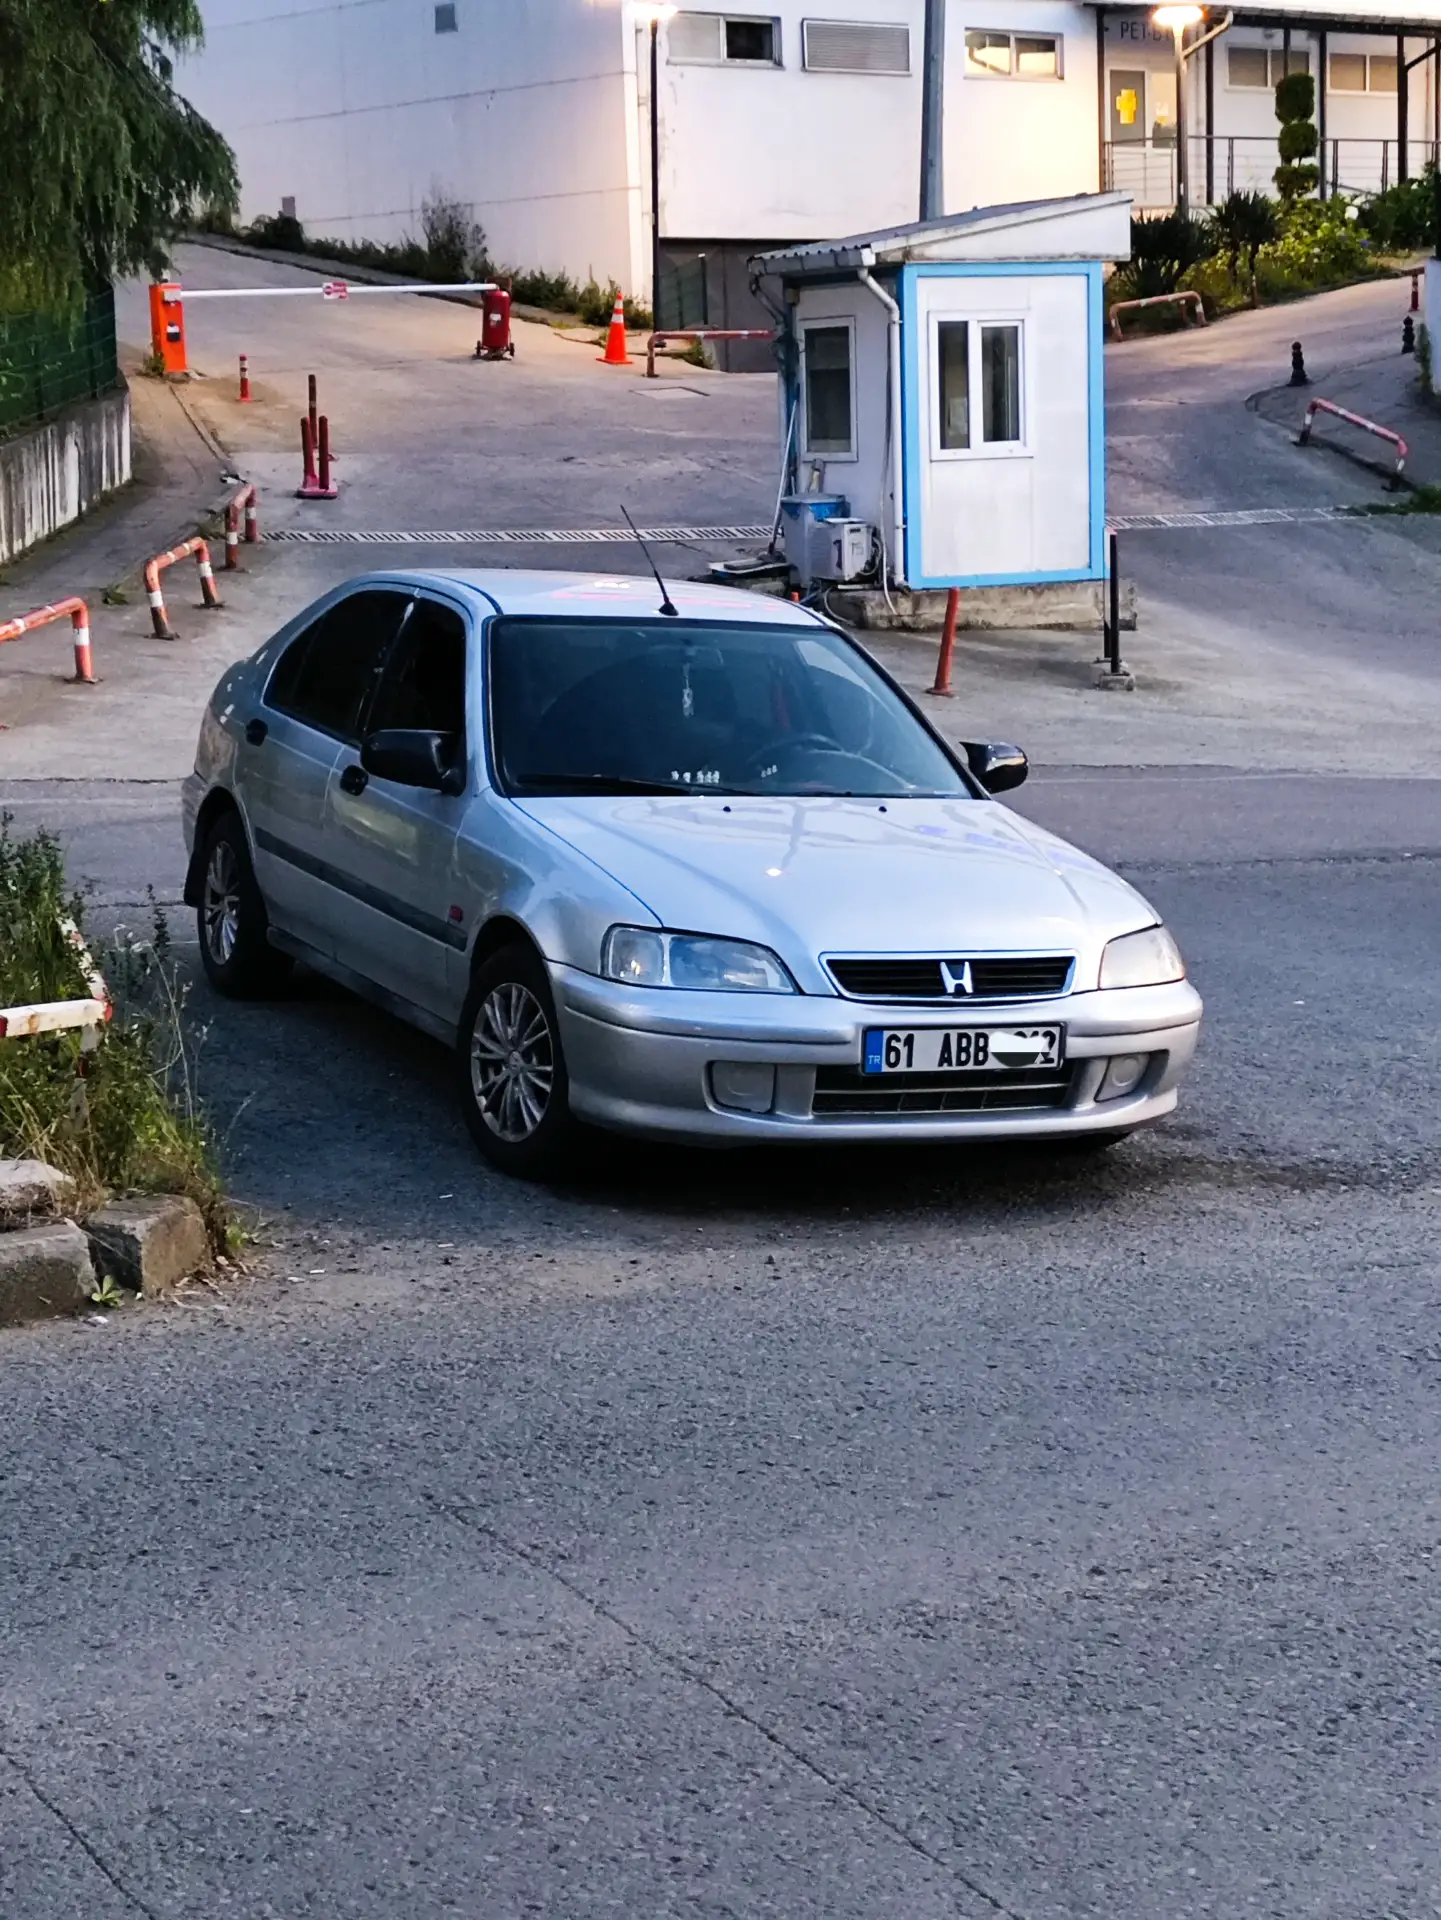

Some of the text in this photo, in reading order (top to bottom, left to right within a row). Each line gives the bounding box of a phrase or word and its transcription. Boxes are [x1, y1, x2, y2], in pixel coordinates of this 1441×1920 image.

[868, 1055, 880, 1065] TR
[885, 1033, 914, 1068] 61
[937, 1031, 989, 1068] ABB
